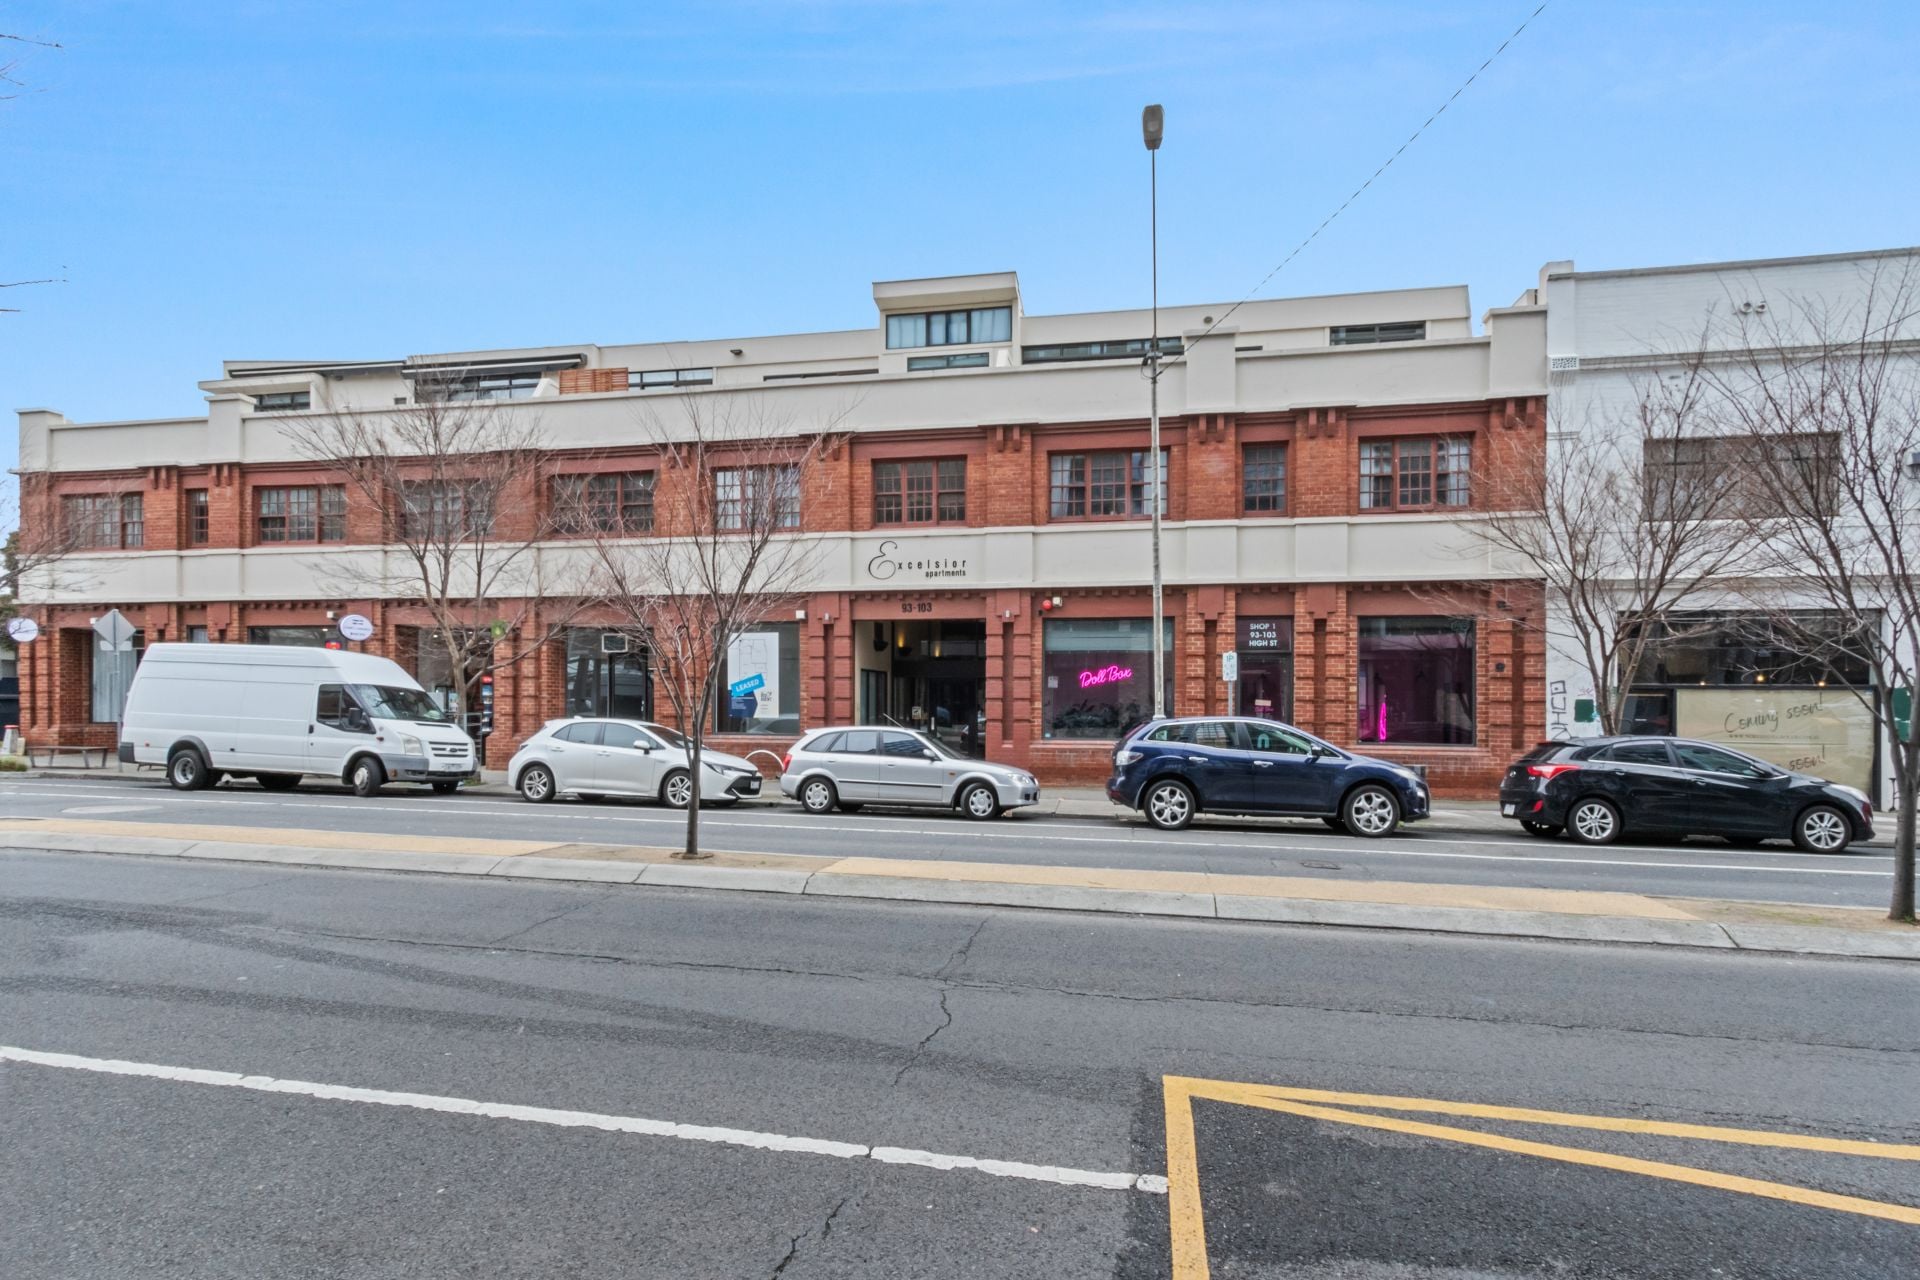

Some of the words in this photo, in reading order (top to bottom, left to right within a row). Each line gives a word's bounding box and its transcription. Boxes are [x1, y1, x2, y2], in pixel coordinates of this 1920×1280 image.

[868, 540, 966, 580] Excelsior
[925, 569, 966, 578] apartments
[735, 678, 760, 692] LEASED
[1079, 669, 1106, 688] Doll
[1106, 665, 1132, 682] Box
[1724, 711, 1779, 733] Coming
